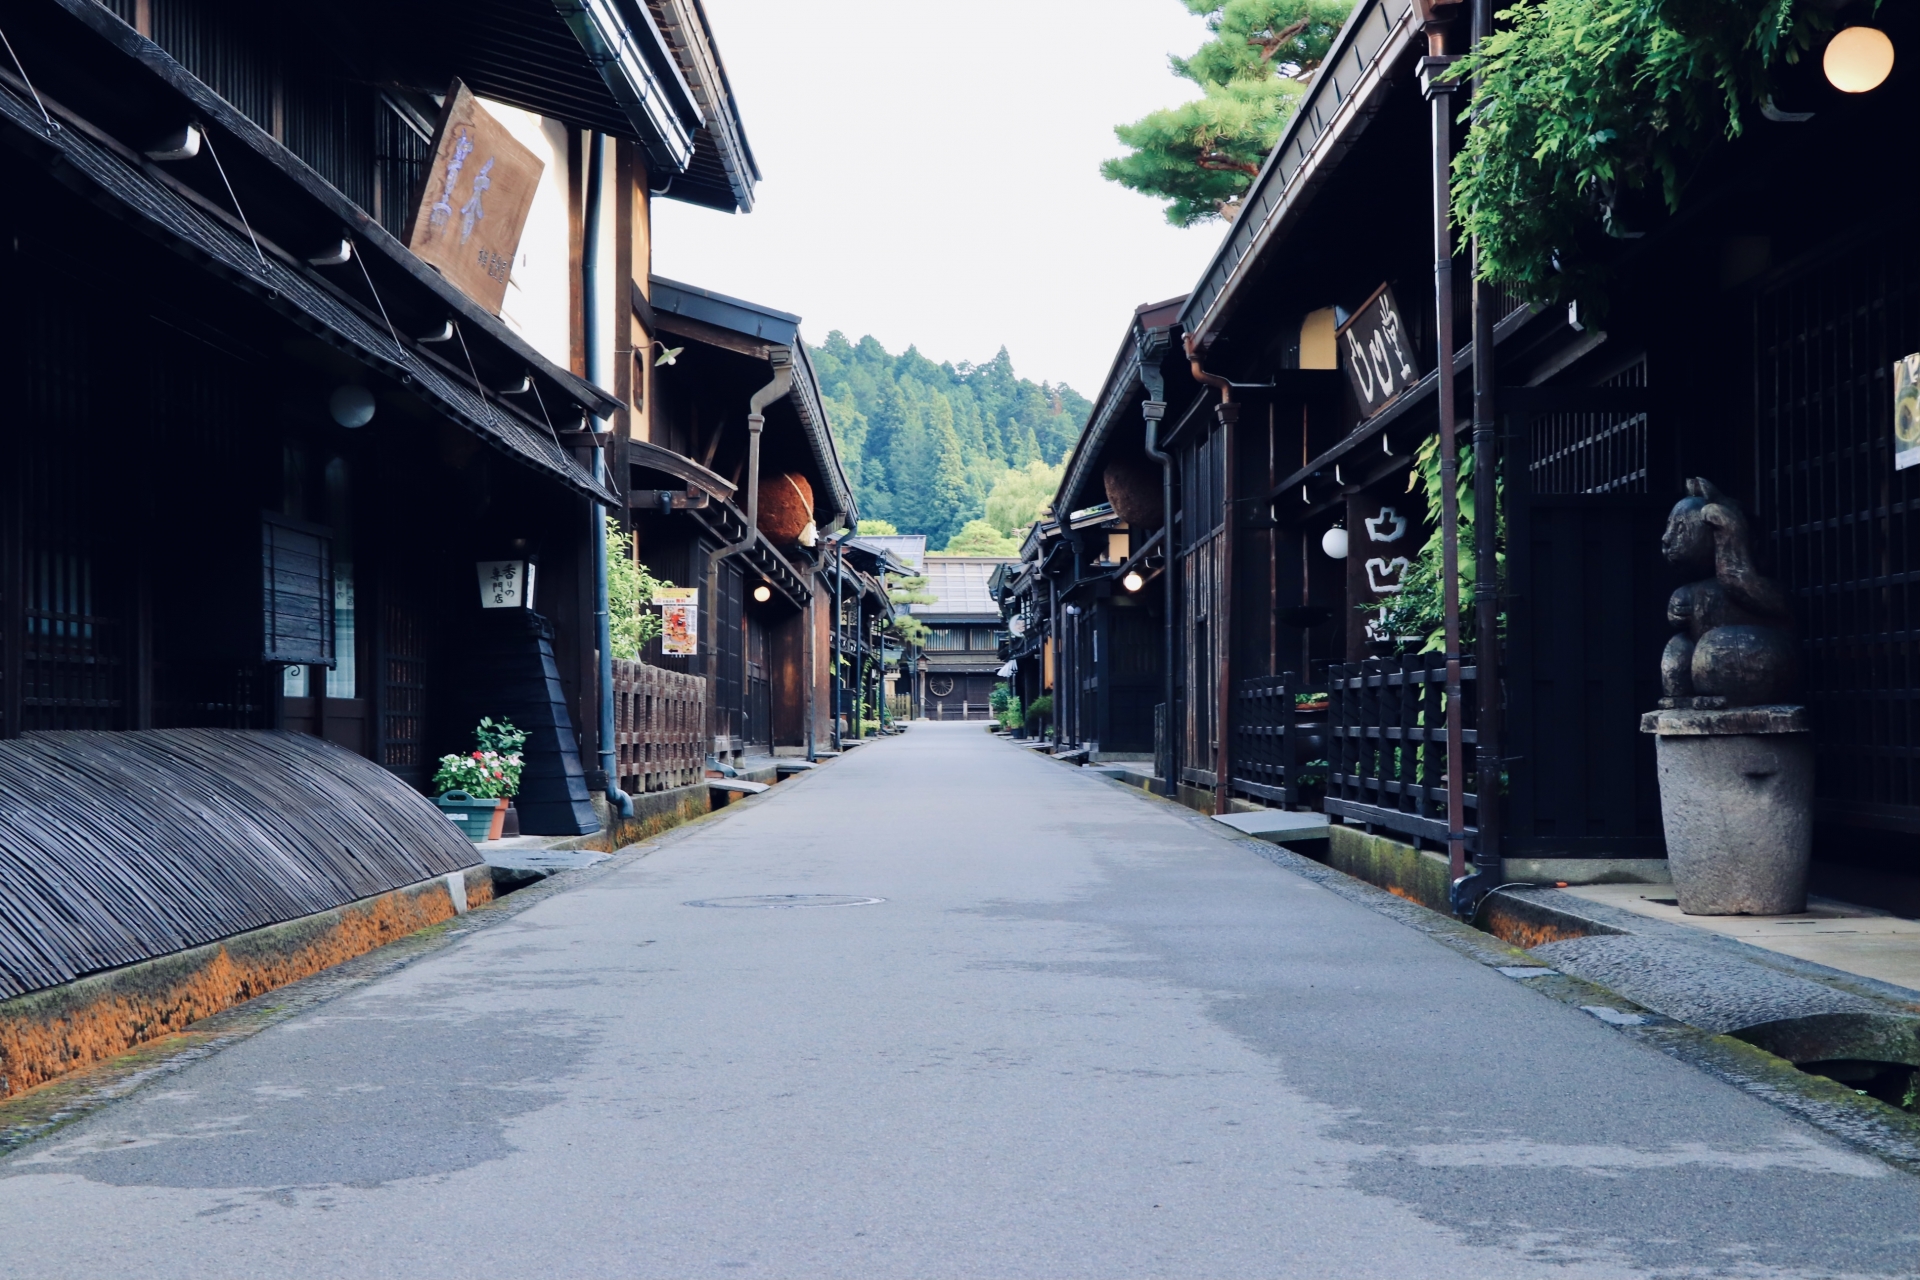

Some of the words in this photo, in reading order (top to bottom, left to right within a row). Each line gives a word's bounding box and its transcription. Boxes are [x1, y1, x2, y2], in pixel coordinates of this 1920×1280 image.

[490, 566, 504, 604] 専門店
[502, 563, 516, 597] 香りの
